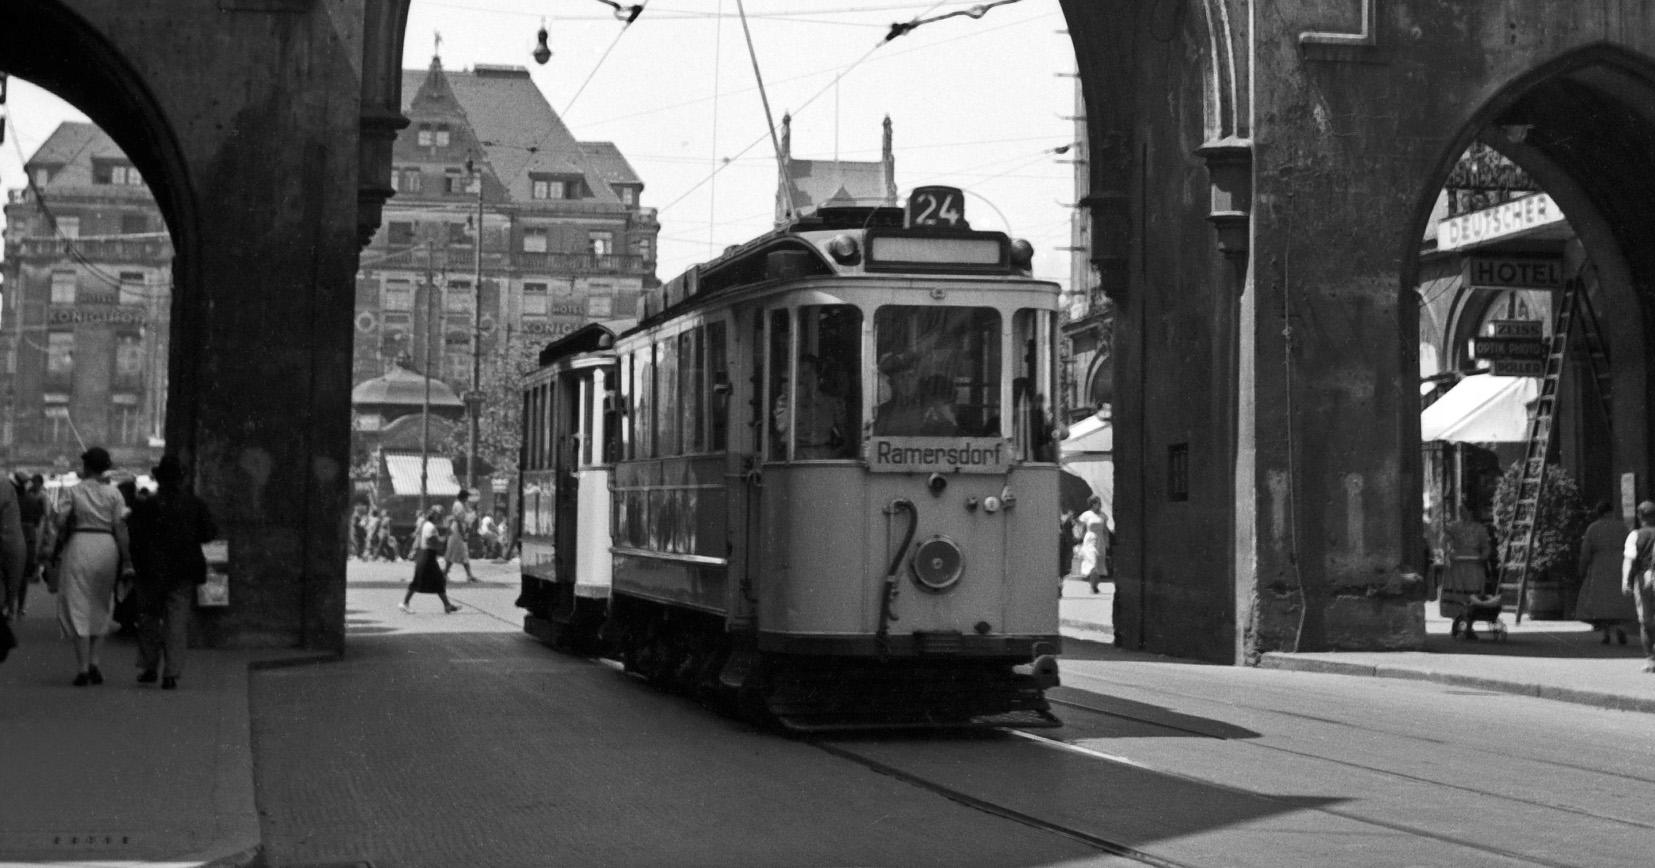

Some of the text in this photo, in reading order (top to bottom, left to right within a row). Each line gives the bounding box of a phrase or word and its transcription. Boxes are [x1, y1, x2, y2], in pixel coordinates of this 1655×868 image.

[915, 193, 960, 227] 24
[1450, 195, 1548, 244] DEUTSCHER
[1478, 262, 1559, 285] HOTEL
[552, 304, 584, 315] HOTEL
[1498, 323, 1541, 336] ZEISS
[1476, 342, 1505, 354] OPTIK
[876, 440, 1002, 465] Ramersdorf
